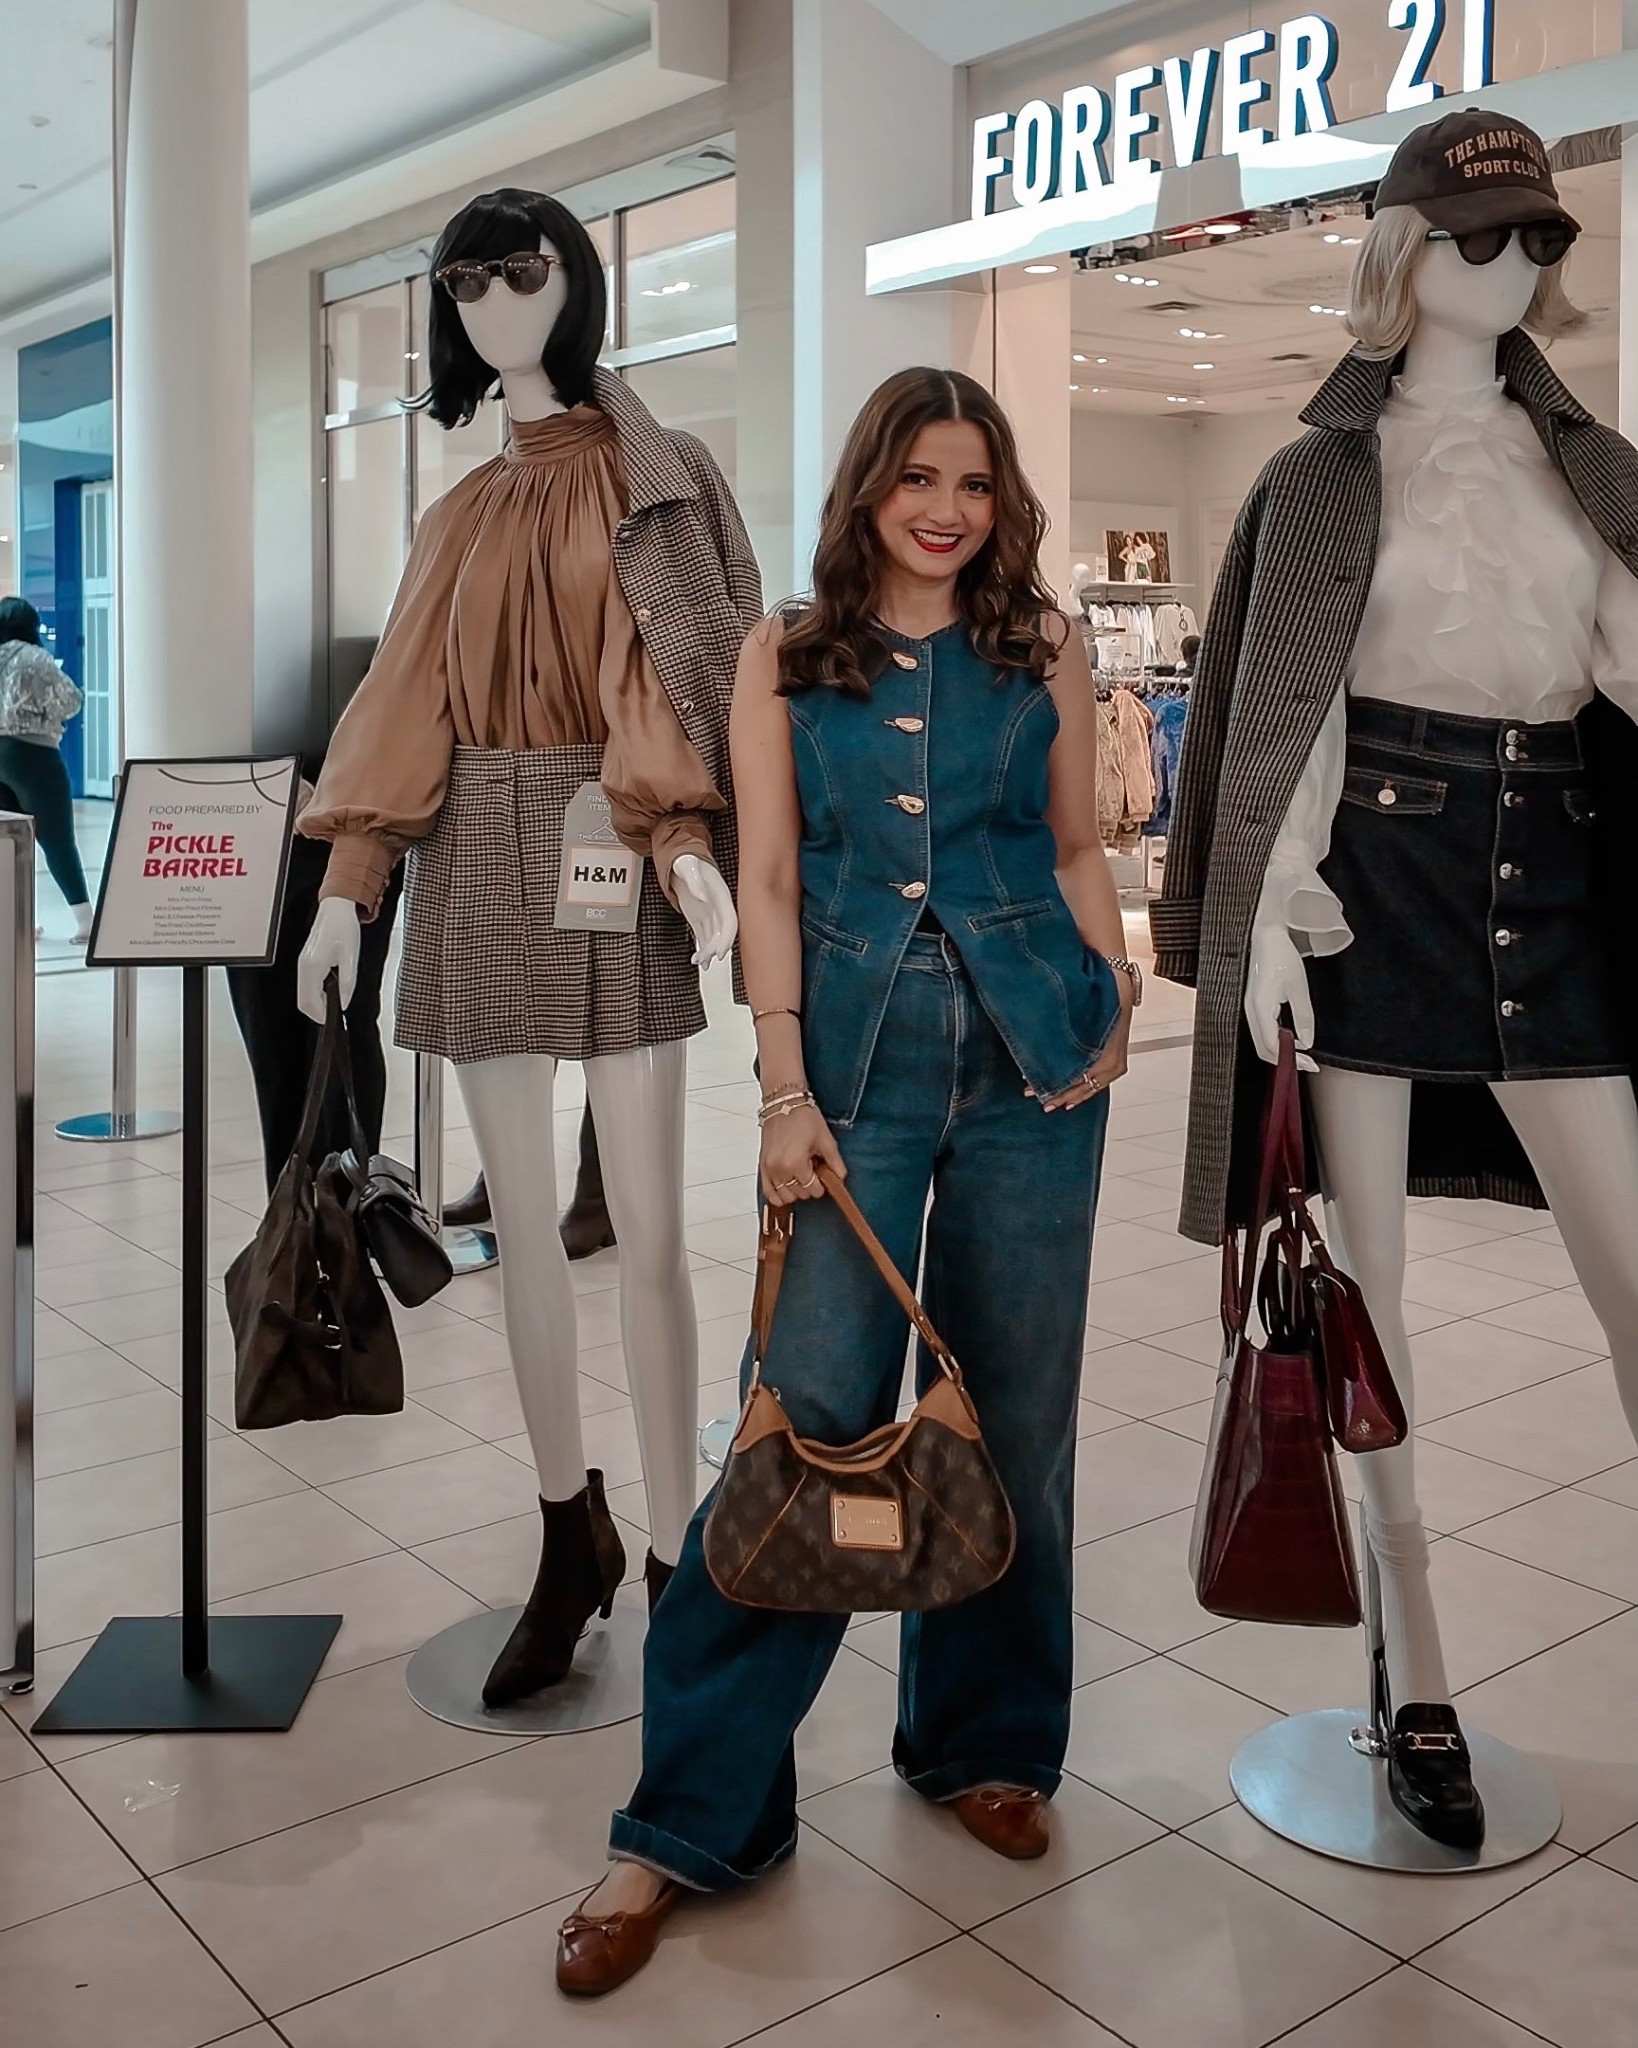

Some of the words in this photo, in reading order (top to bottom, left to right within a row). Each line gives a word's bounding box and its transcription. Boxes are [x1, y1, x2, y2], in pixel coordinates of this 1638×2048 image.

[972, 13, 1339, 219] FOREVER
[1385, 0, 1498, 114] 21
[1444, 138, 1476, 168] THE
[1463, 159, 1511, 178] SPORT
[1512, 160, 1540, 179] CLUB
[148, 805, 183, 815] FOOD
[184, 804, 245, 815] PREPARED
[246, 804, 262, 814] BY
[151, 821, 173, 831] The
[147, 835, 235, 854] PICKLE
[143, 857, 248, 879] BARREL
[573, 866, 627, 884] H&M
[180, 885, 205, 893] MENU
